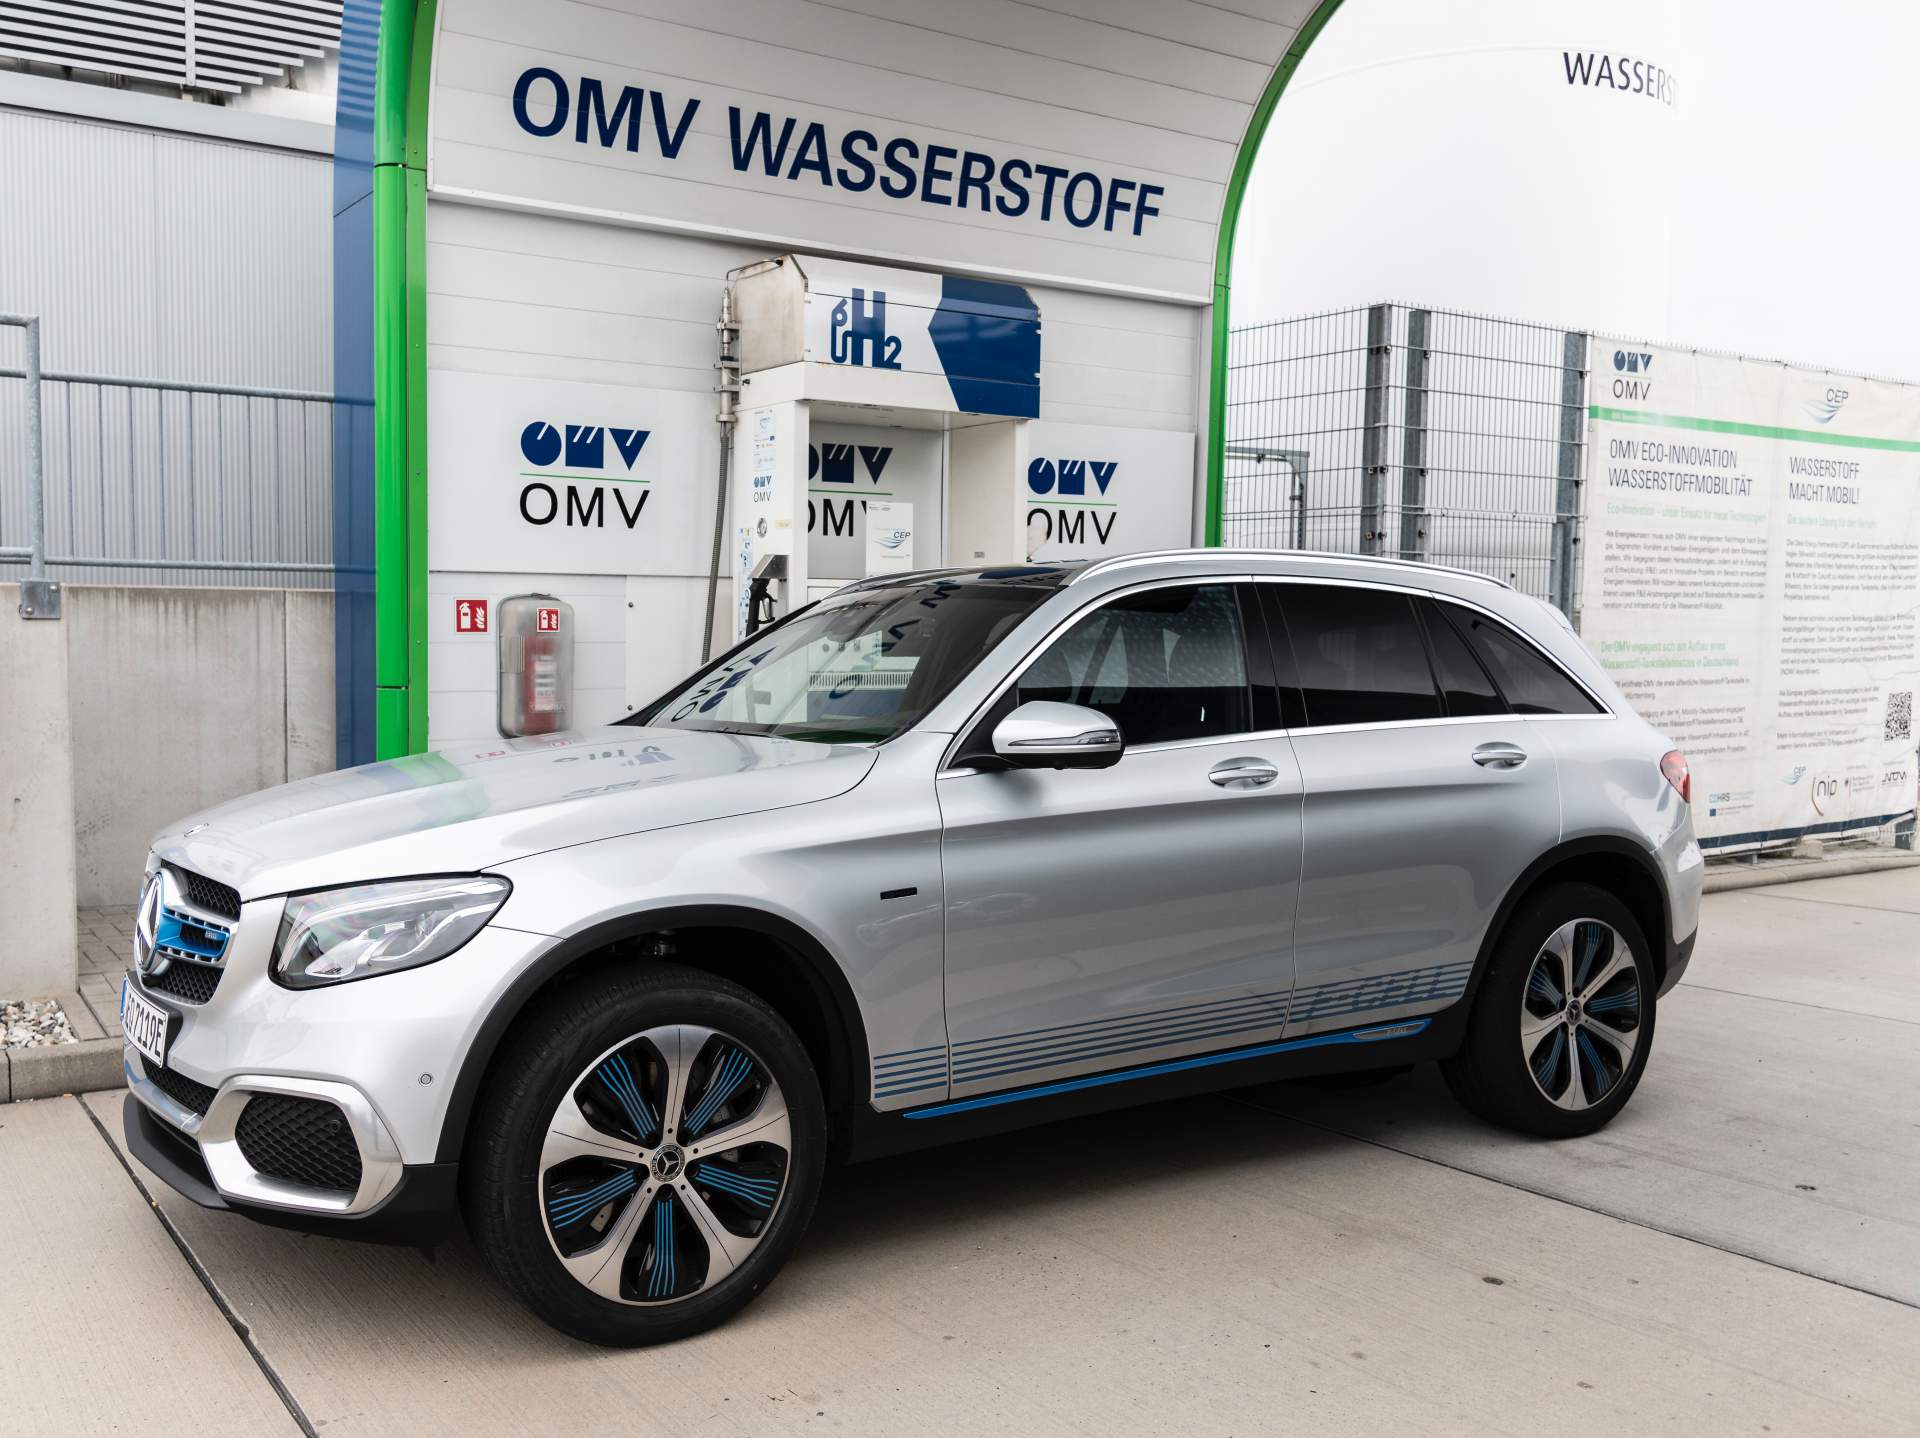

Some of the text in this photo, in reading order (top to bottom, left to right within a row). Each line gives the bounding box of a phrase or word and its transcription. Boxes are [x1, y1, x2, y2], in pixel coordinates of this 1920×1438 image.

[512, 66, 1165, 236] OMV WASSERSTOFF
[1612, 379, 1651, 401] OMV
[1826, 388, 1849, 404] CEP
[1609, 438, 1738, 469] OMV ECO-INNOVATION
[1789, 456, 1861, 480] WASSERSTOFF
[1608, 467, 1753, 497] WASSERSTOFFMOBILITÄT
[1788, 482, 1825, 502] MACHT
[519, 482, 651, 529] OMV
[753, 490, 772, 503] OMV
[893, 531, 911, 540] CEP
[1026, 507, 1118, 545] OMV
